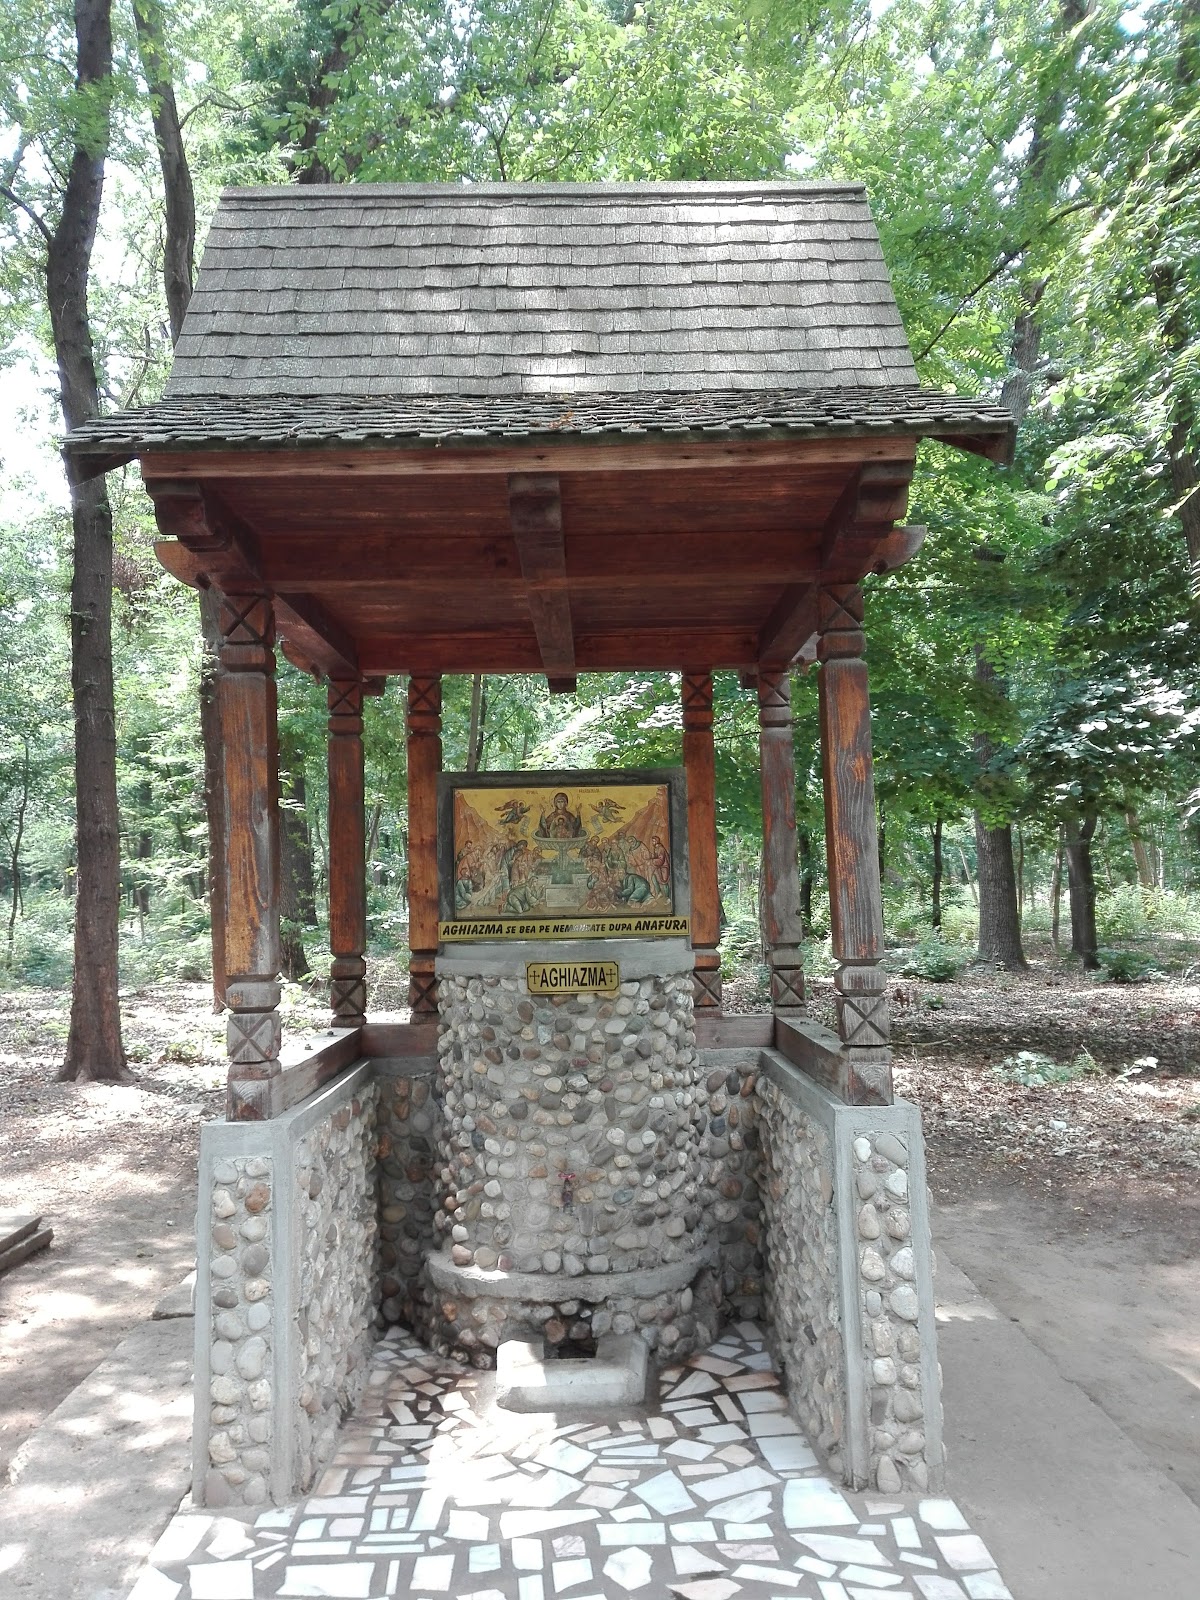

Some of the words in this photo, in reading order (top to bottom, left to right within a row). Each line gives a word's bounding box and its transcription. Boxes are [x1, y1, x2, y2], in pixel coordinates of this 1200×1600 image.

[442, 924, 503, 936] AGHIAZMA
[505, 925, 516, 934] SE
[519, 925, 536, 934] BEA
[538, 924, 550, 933] PE
[608, 923, 632, 932] DUPA
[634, 919, 688, 931] ANAFURA
[540, 967, 607, 988] AGHIAZMA
